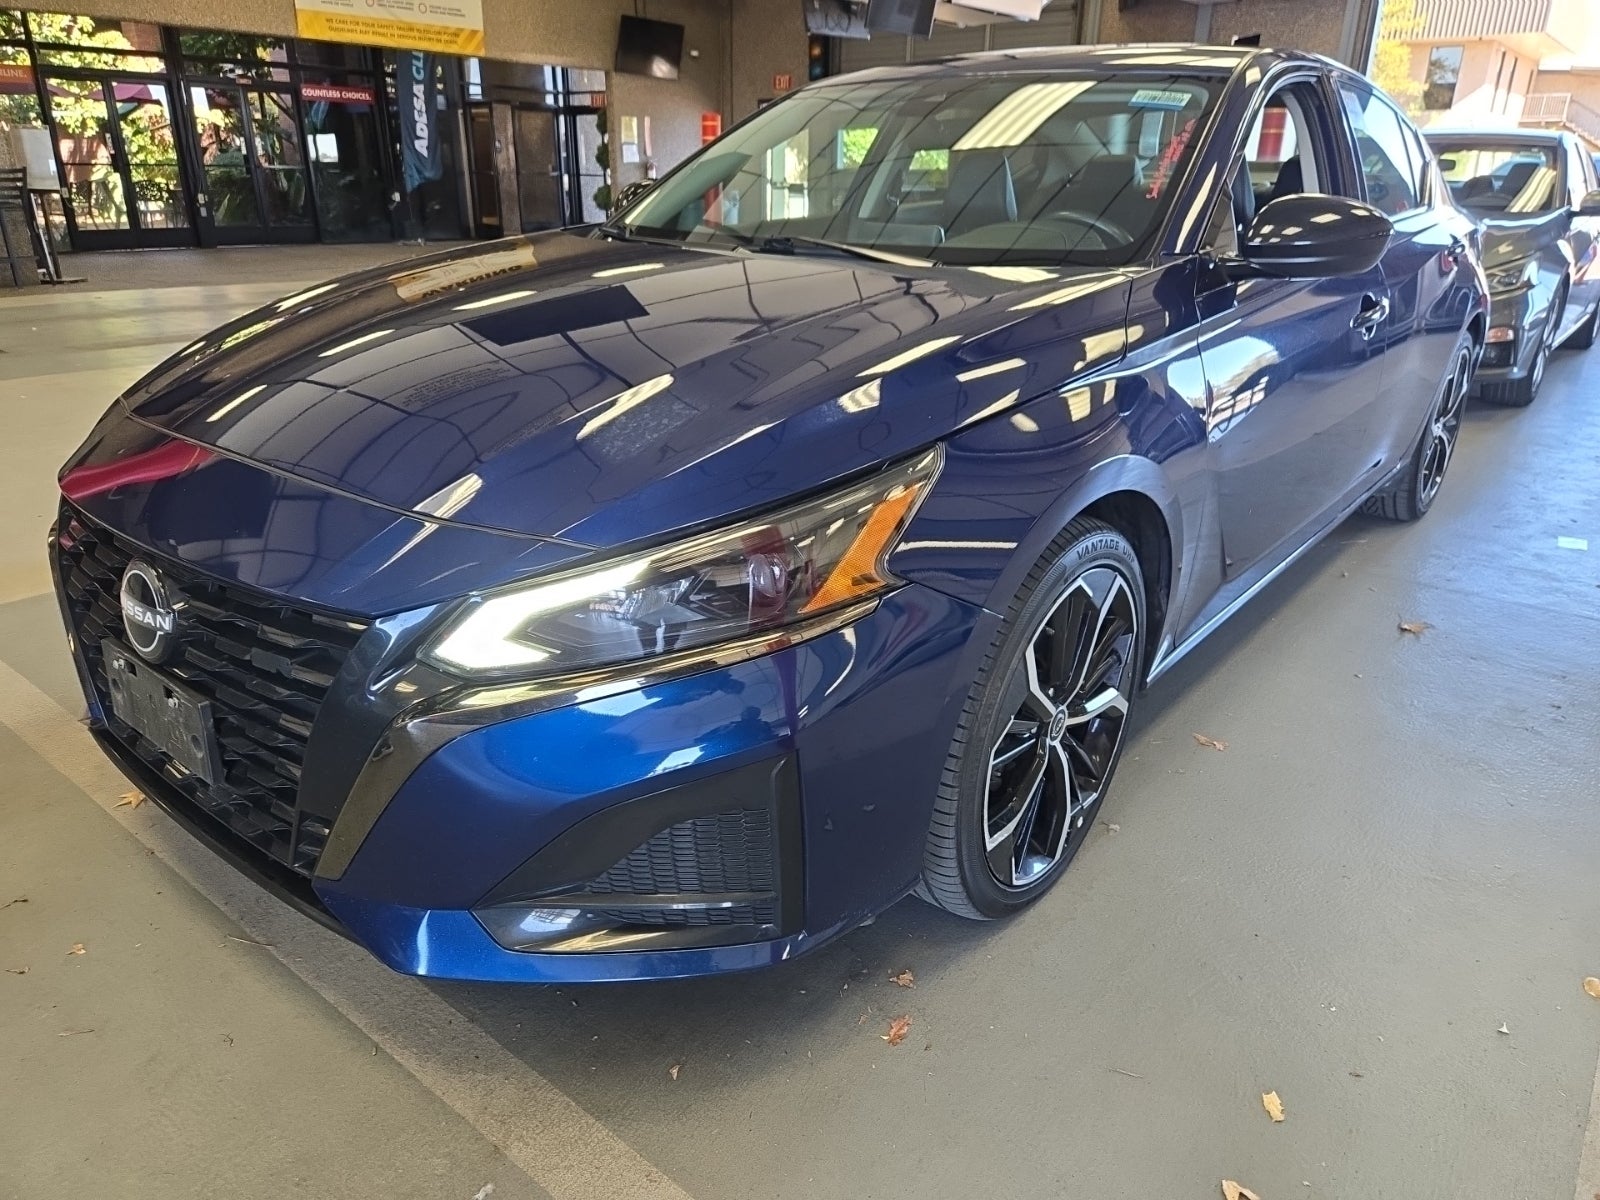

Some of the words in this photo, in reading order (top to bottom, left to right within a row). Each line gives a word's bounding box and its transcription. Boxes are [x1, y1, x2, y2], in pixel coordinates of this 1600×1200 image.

[776, 75, 790, 89] EXIT
[302, 88, 341, 98] COUNTLESS
[341, 91, 372, 100] CHOICES.
[412, 81, 429, 158] ADESA
[1076, 538, 1120, 560] VANTAGE
